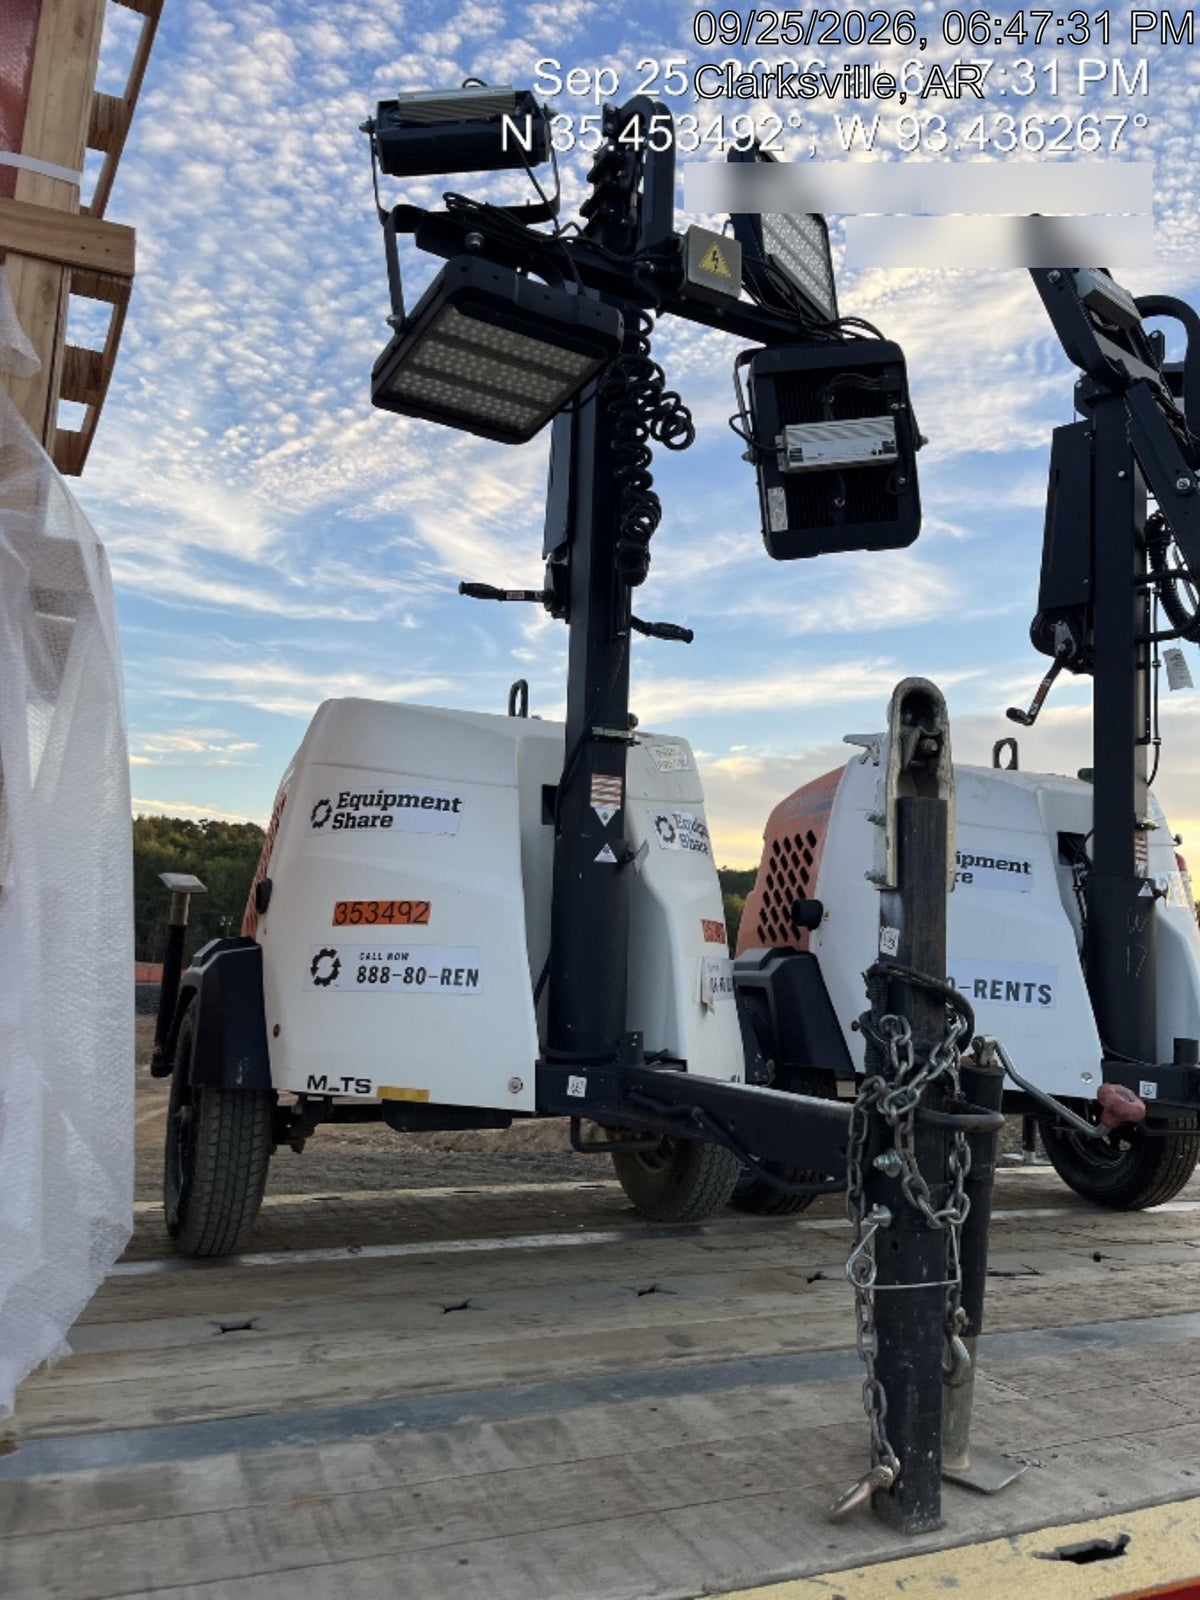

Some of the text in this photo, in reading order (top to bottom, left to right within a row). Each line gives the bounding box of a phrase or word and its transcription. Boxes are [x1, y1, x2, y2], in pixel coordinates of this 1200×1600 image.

[336, 789, 462, 814] Equipment
[331, 812, 393, 830] Share
[955, 850, 1032, 875] ipment
[334, 900, 430, 925] 353492
[356, 965, 479, 988] 888-80-REN
